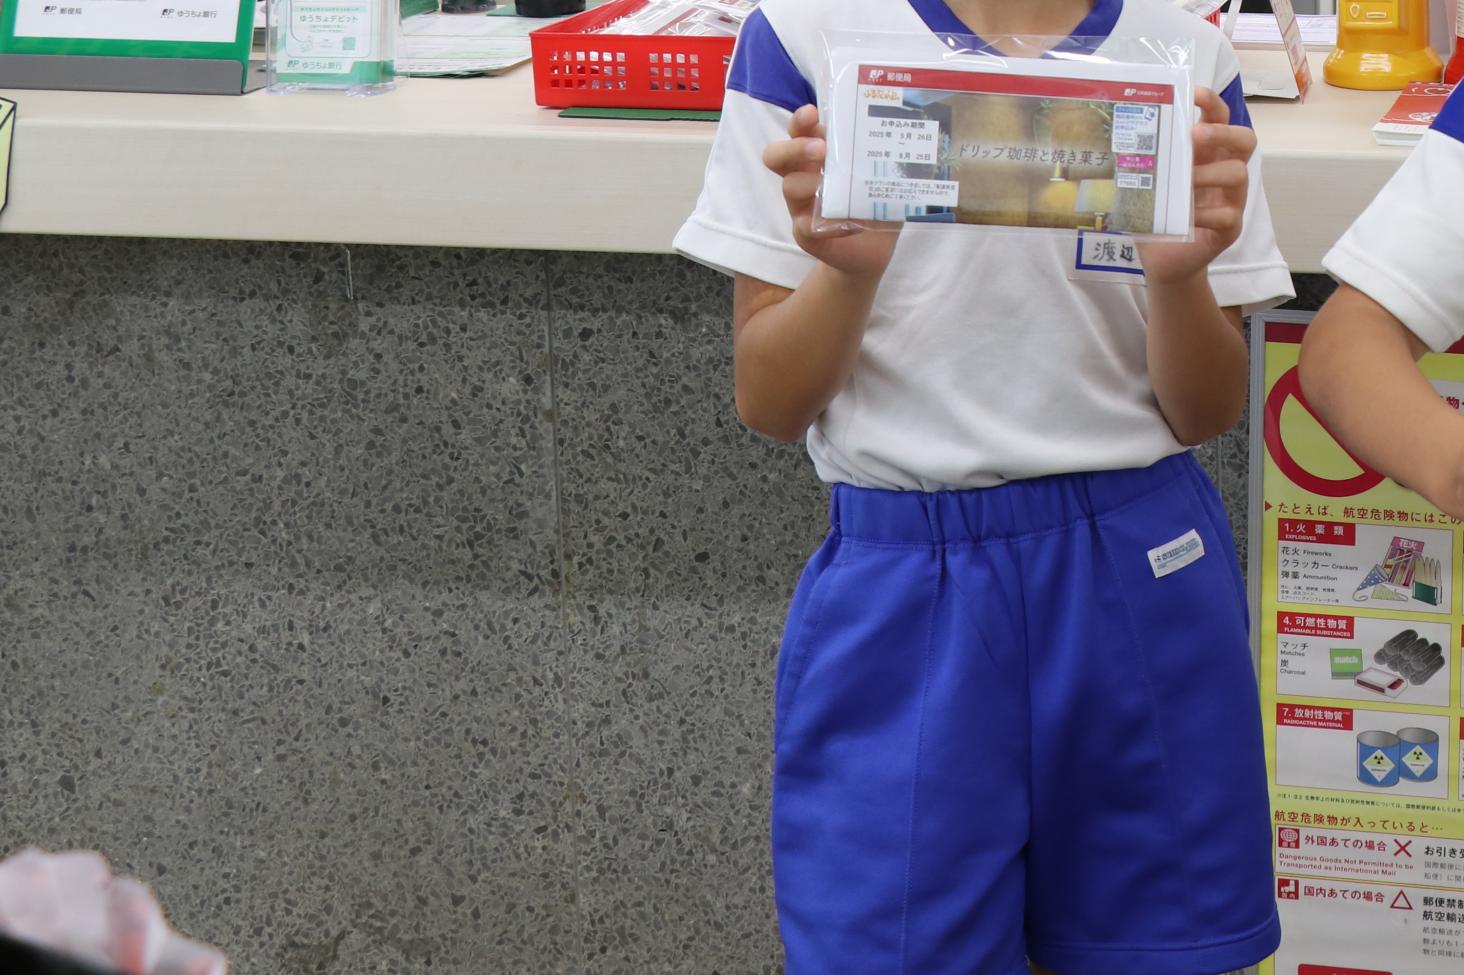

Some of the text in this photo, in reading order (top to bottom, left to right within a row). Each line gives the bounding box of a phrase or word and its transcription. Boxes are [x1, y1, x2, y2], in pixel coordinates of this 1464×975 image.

[887, 72, 912, 82] 郵便局
[881, 120, 925, 129] お申込み期間
[959, 143, 1110, 166] ドリップ珈琲と焼き菓子
[1281, 546, 1332, 557] 花火 Fireworks
[1281, 558, 1330, 569] クラッカー
[1281, 571, 1338, 581] 弾薬 Ammunition
[1295, 617, 1347, 629] 可燃性物質
[1284, 627, 1350, 637] FLAMMABLE SUBSTANCES
[1281, 641, 1309, 650] マッチ
[1280, 659, 1289, 668] 炭
[1294, 708, 1343, 721] 放射性物質
[1283, 718, 1318, 726] RADIOACTIVE
[1305, 835, 1388, 852] 外国あての場合
[1279, 853, 1318, 862] Dangerous
[1359, 860, 1394, 869] Permitted
[1279, 861, 1322, 871] Transported
[1334, 865, 1380, 875] International
[1304, 886, 1385, 903] 国内あての場合
